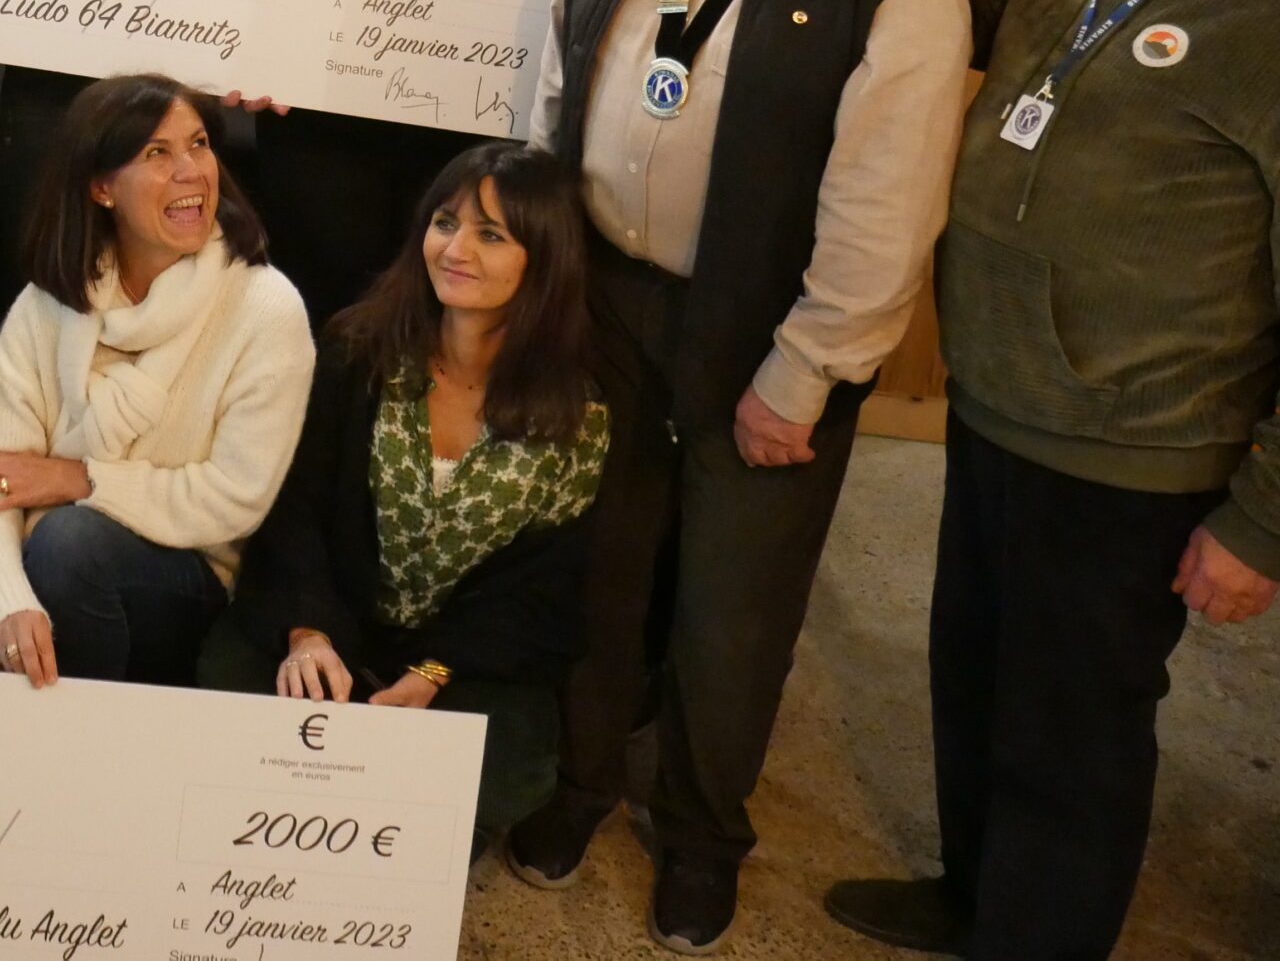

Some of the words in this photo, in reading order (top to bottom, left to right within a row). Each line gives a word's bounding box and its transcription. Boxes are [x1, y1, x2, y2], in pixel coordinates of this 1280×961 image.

[333, 0, 342, 9] A
[78, 0, 123, 30] 64
[125, 6, 241, 60] Biarritz
[329, 31, 344, 43] LE
[356, 26, 381, 47] 19
[374, 33, 459, 61] janvier
[464, 41, 528, 69] 2023
[1079, 18, 1114, 51] KIWANIS
[325, 59, 383, 78] Signature
[298, 713, 329, 750] €
[269, 758, 299, 770] rédiger
[302, 761, 365, 774] exclusivement
[291, 771, 303, 780] en
[305, 773, 331, 782] euros
[232, 811, 359, 854] 2000
[371, 825, 401, 857] €
[176, 882, 186, 892] A
[211, 869, 297, 910] Anglet
[31, 910, 127, 960] Anglet
[173, 919, 190, 930] LE
[205, 910, 235, 935] 19
[226, 916, 328, 949] janvier
[334, 921, 412, 949] 2023
